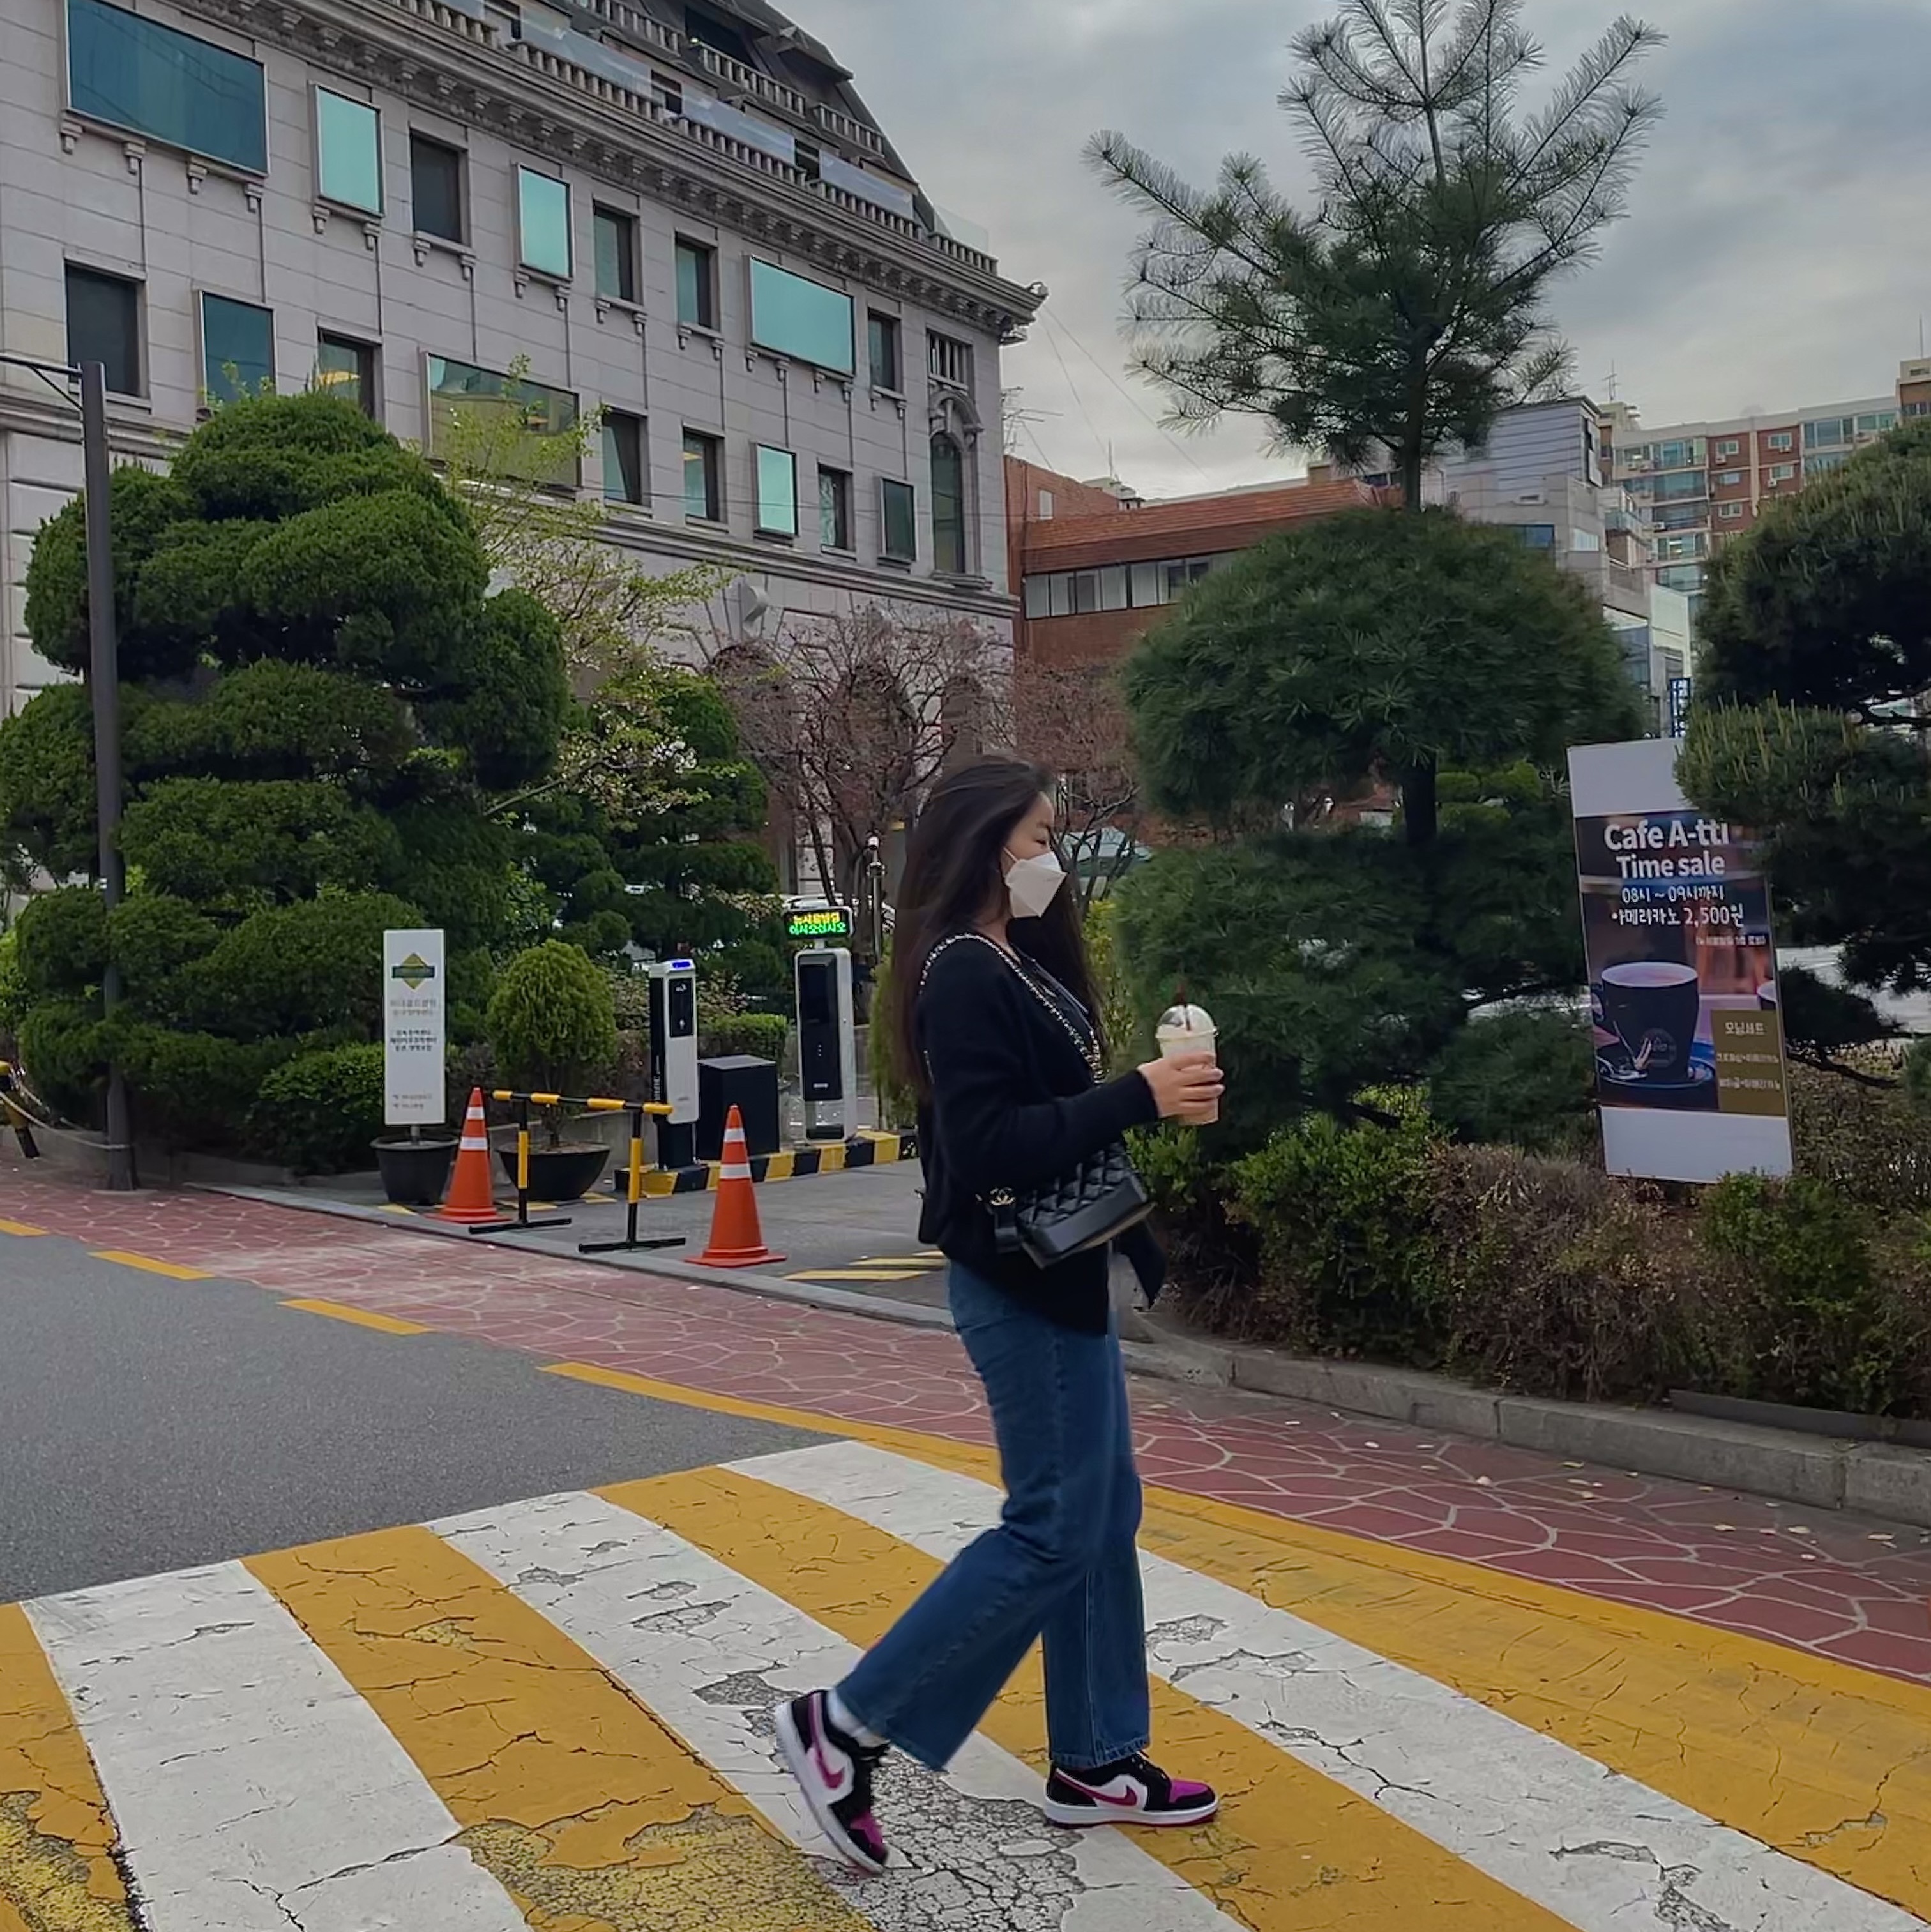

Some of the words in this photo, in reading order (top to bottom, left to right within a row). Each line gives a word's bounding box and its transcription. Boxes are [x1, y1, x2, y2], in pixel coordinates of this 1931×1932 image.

[1604, 819, 1664, 851] Cafe
[1616, 853, 1674, 879] Time
[1677, 850, 1725, 876] sale
[1621, 887, 1651, 904] 08시
[1667, 885, 1725, 902] 09시까지
[1611, 907, 1681, 925] 아메리카노
[1683, 903, 1745, 928] 2,500원
